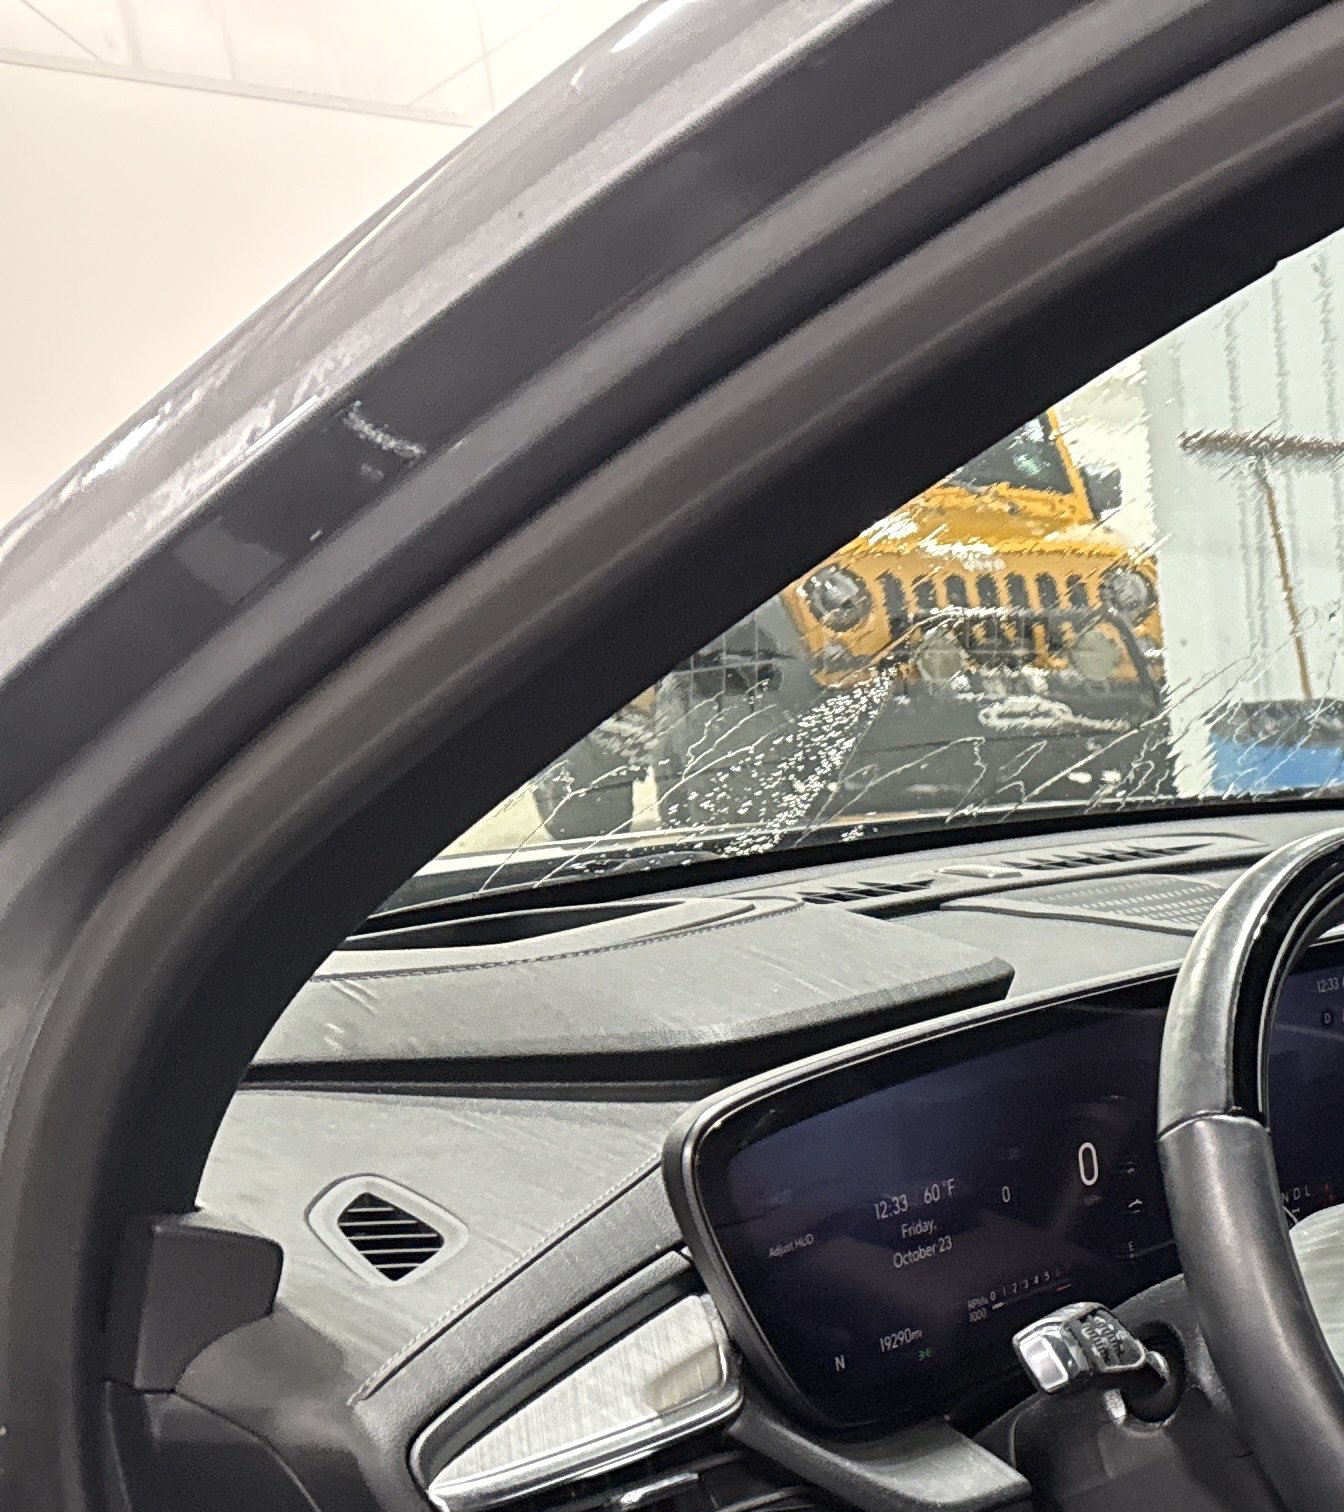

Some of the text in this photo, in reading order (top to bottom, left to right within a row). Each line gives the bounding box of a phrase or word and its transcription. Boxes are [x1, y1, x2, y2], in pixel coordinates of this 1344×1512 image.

[1078, 1142, 1099, 1186] 0
[1001, 1185, 1011, 1203] 0
[874, 1194, 909, 1221] 12:33
[795, 1233, 814, 1250] HUD
[893, 1235, 953, 1268] October 23
[835, 1355, 846, 1371] N
